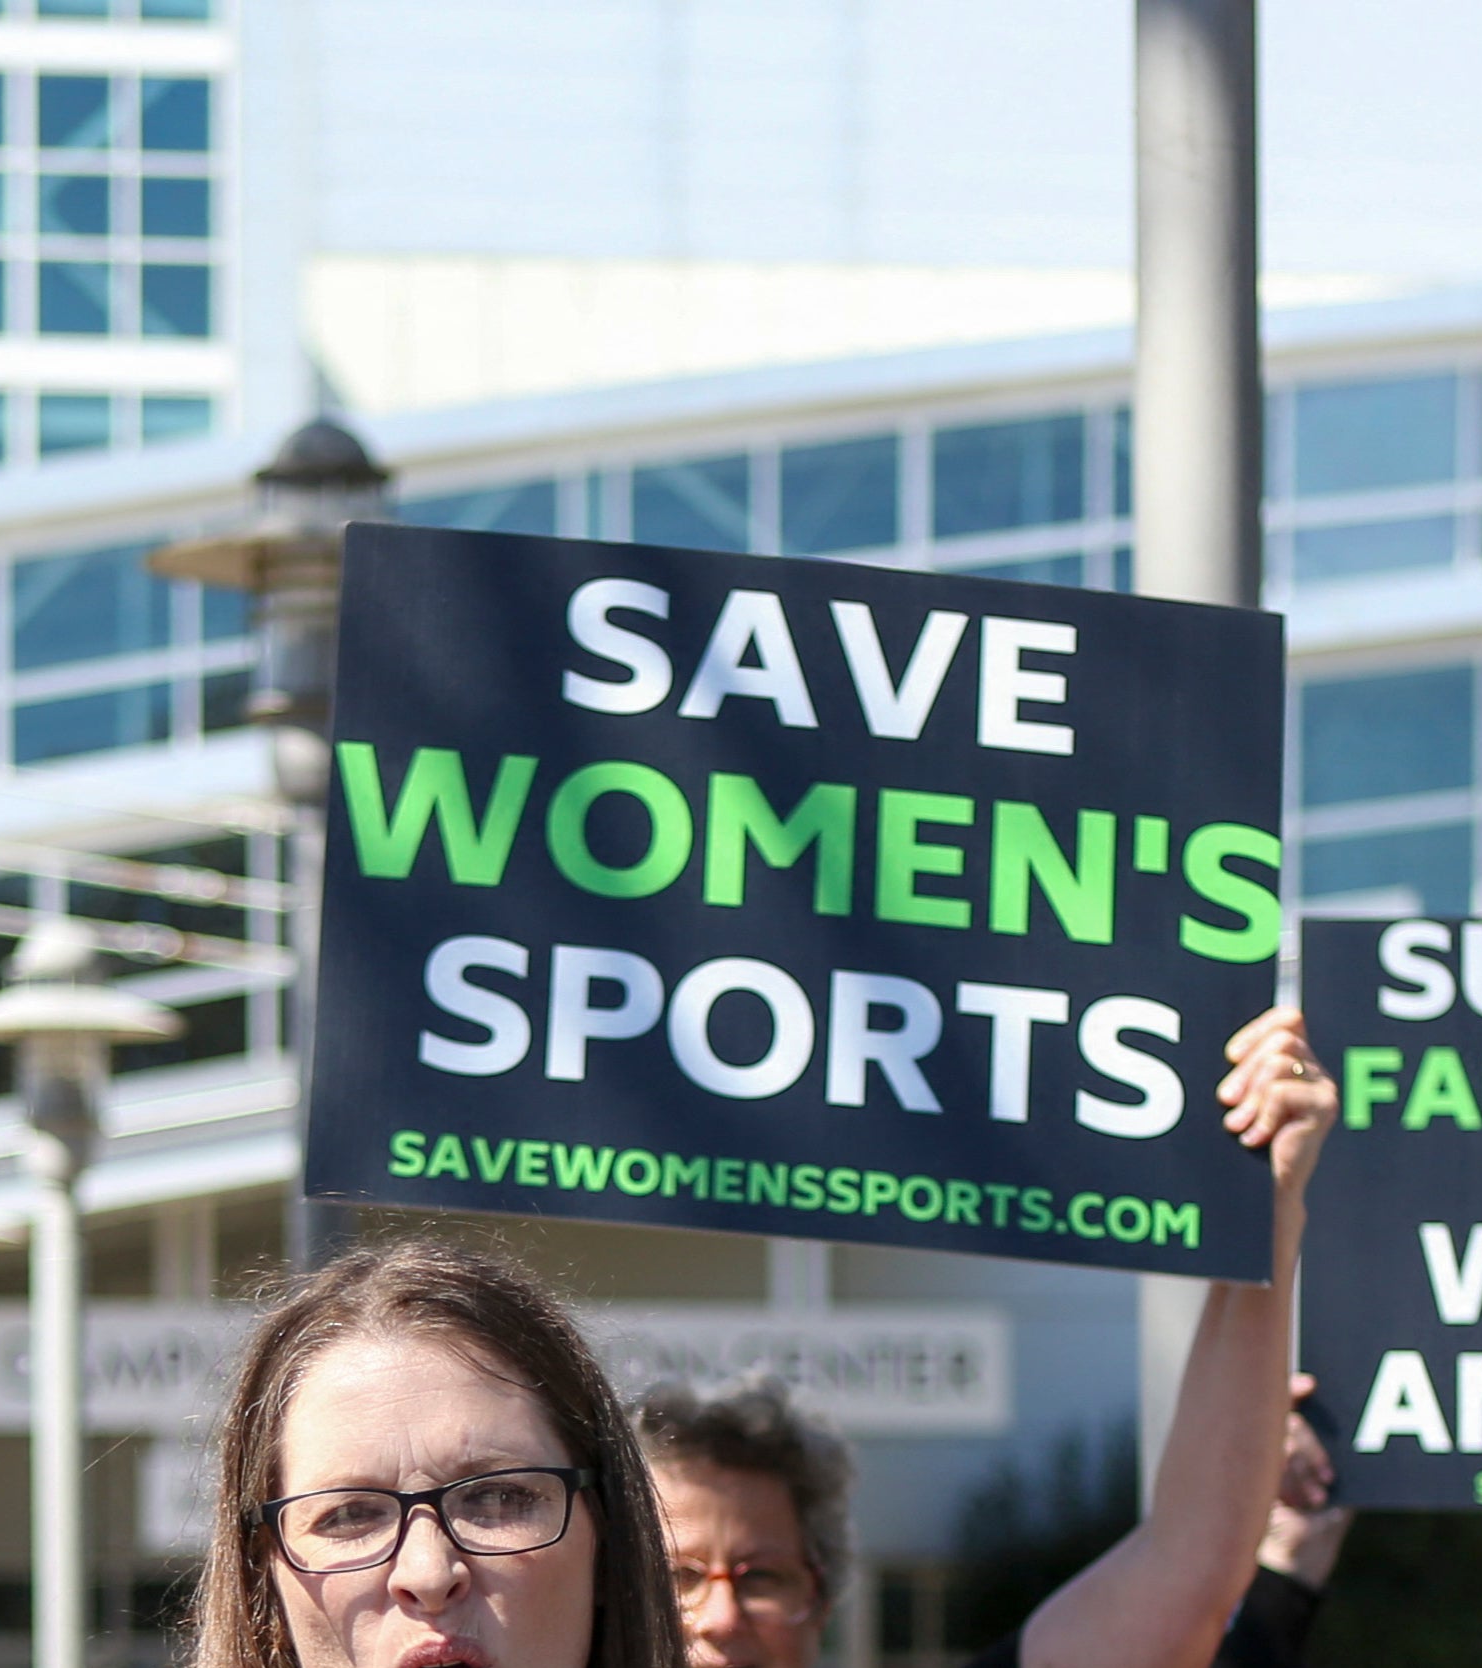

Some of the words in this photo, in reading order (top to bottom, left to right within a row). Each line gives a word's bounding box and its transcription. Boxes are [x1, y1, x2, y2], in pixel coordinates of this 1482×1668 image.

[562, 577, 1077, 756] SAVE
[336, 741, 1282, 964] WOMEN'S
[418, 935, 1185, 1139] SPORTS
[389, 1130, 1201, 1249] SAVEWOMENSSPORTS.COM
